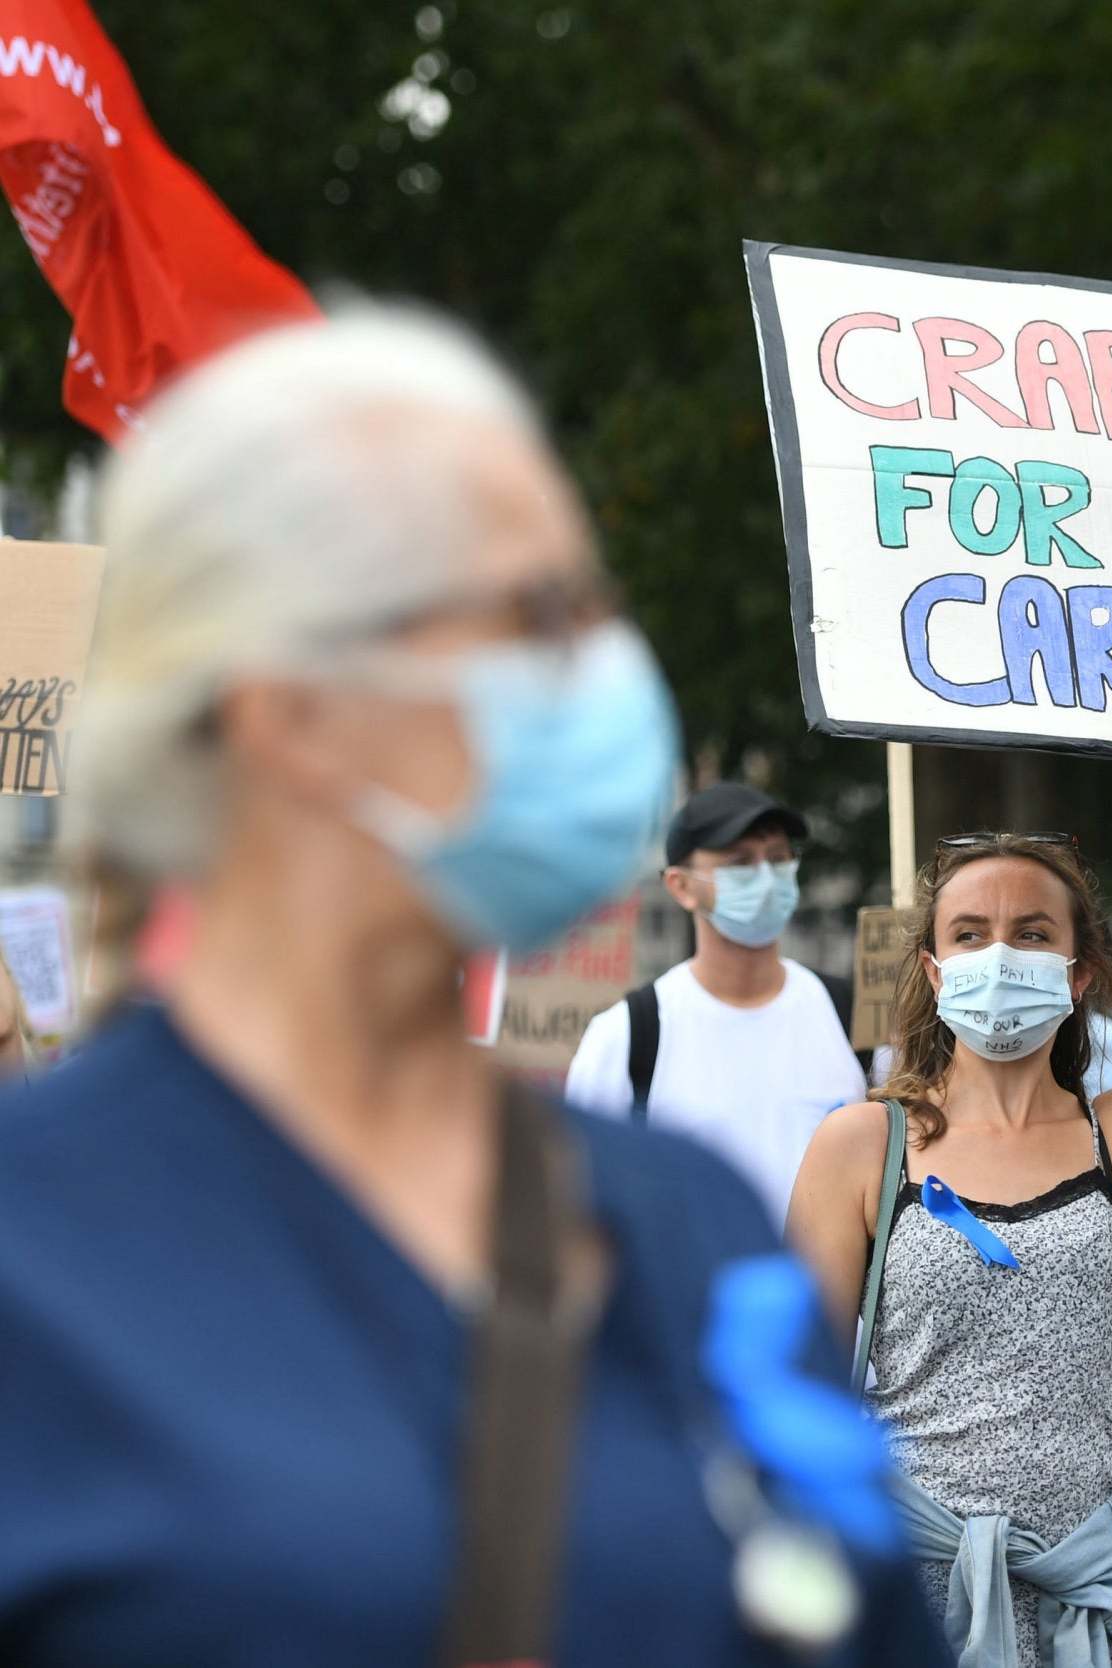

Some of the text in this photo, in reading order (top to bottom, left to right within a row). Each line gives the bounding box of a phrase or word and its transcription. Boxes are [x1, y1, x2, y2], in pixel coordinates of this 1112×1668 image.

[869, 444, 1104, 569] FOR
[993, 1015, 1025, 1031] OUR
[985, 1037, 1024, 1050] NHS
